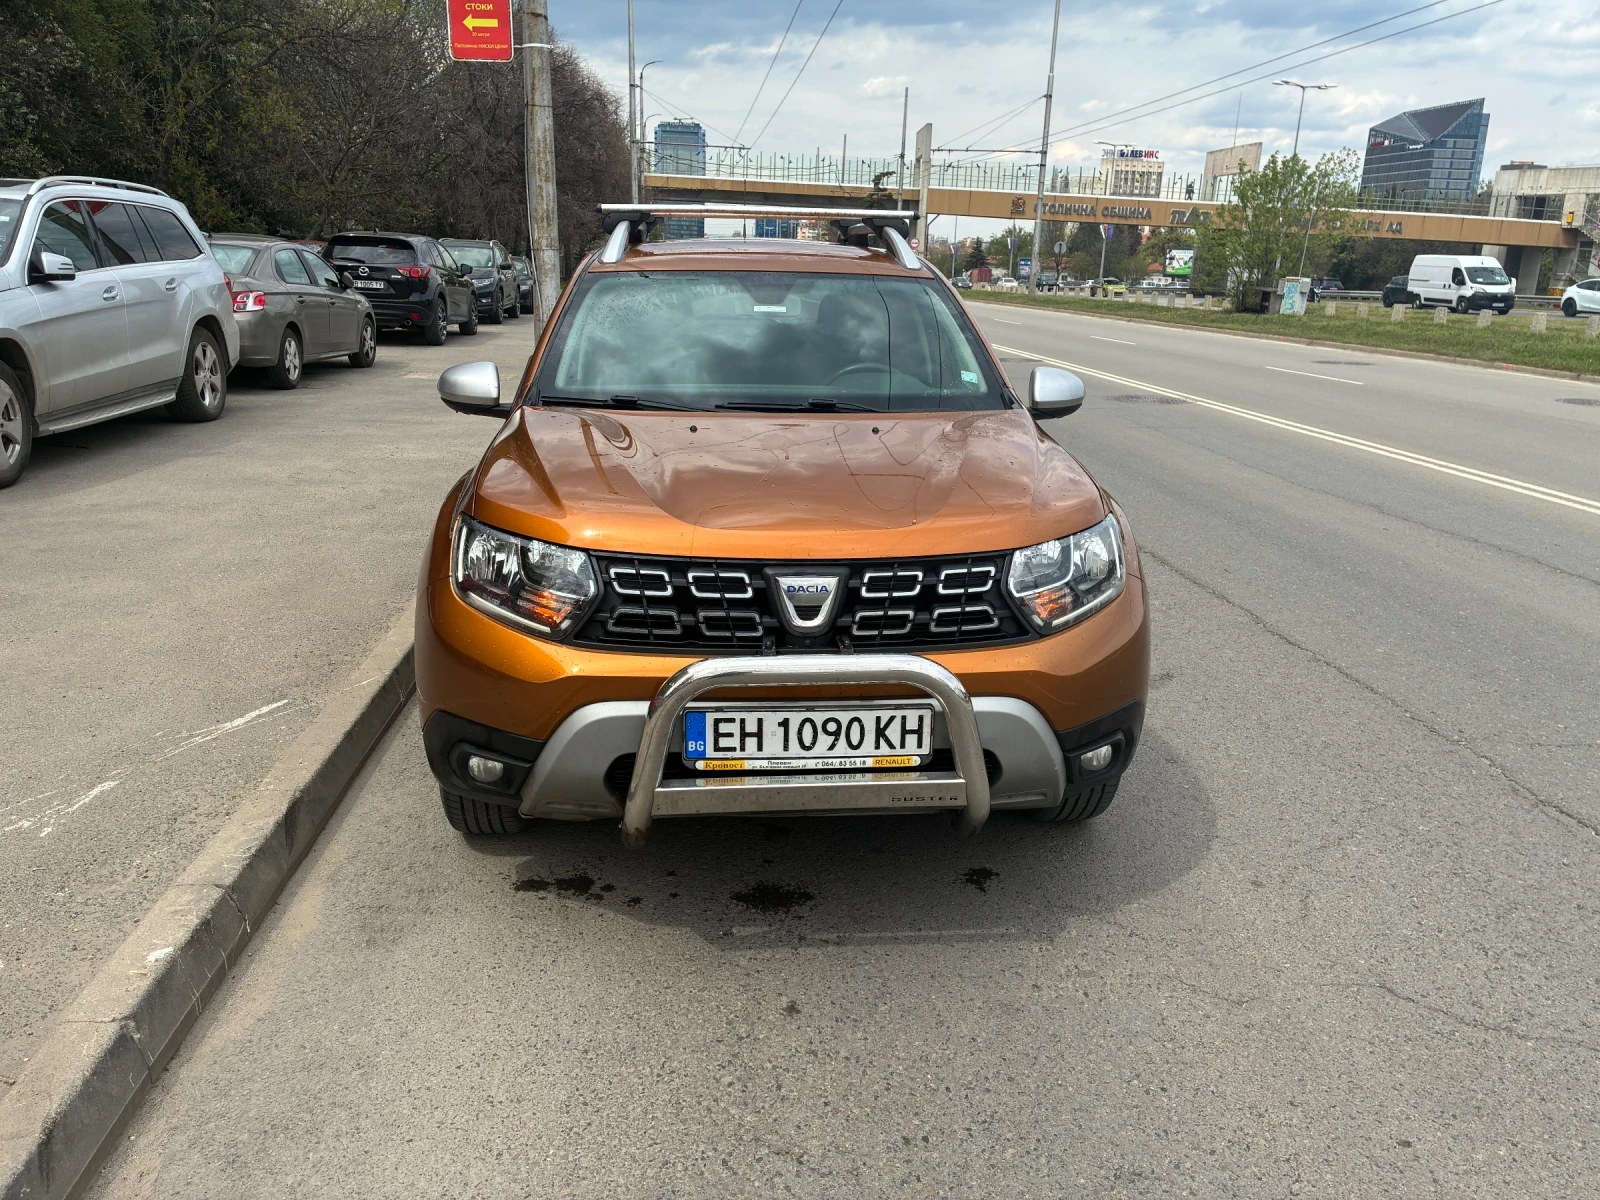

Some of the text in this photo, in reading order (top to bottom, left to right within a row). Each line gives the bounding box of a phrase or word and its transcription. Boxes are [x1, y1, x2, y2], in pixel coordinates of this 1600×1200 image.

[465, 3, 493, 11] СТОКИ
[1144, 149, 1159, 159] ИНС
[1101, 205, 1152, 219] ОБЩИНА
[787, 585, 829, 593] DACIA
[688, 714, 924, 753] BG EH 1090 KH
[875, 758, 912, 766] RENAULT
